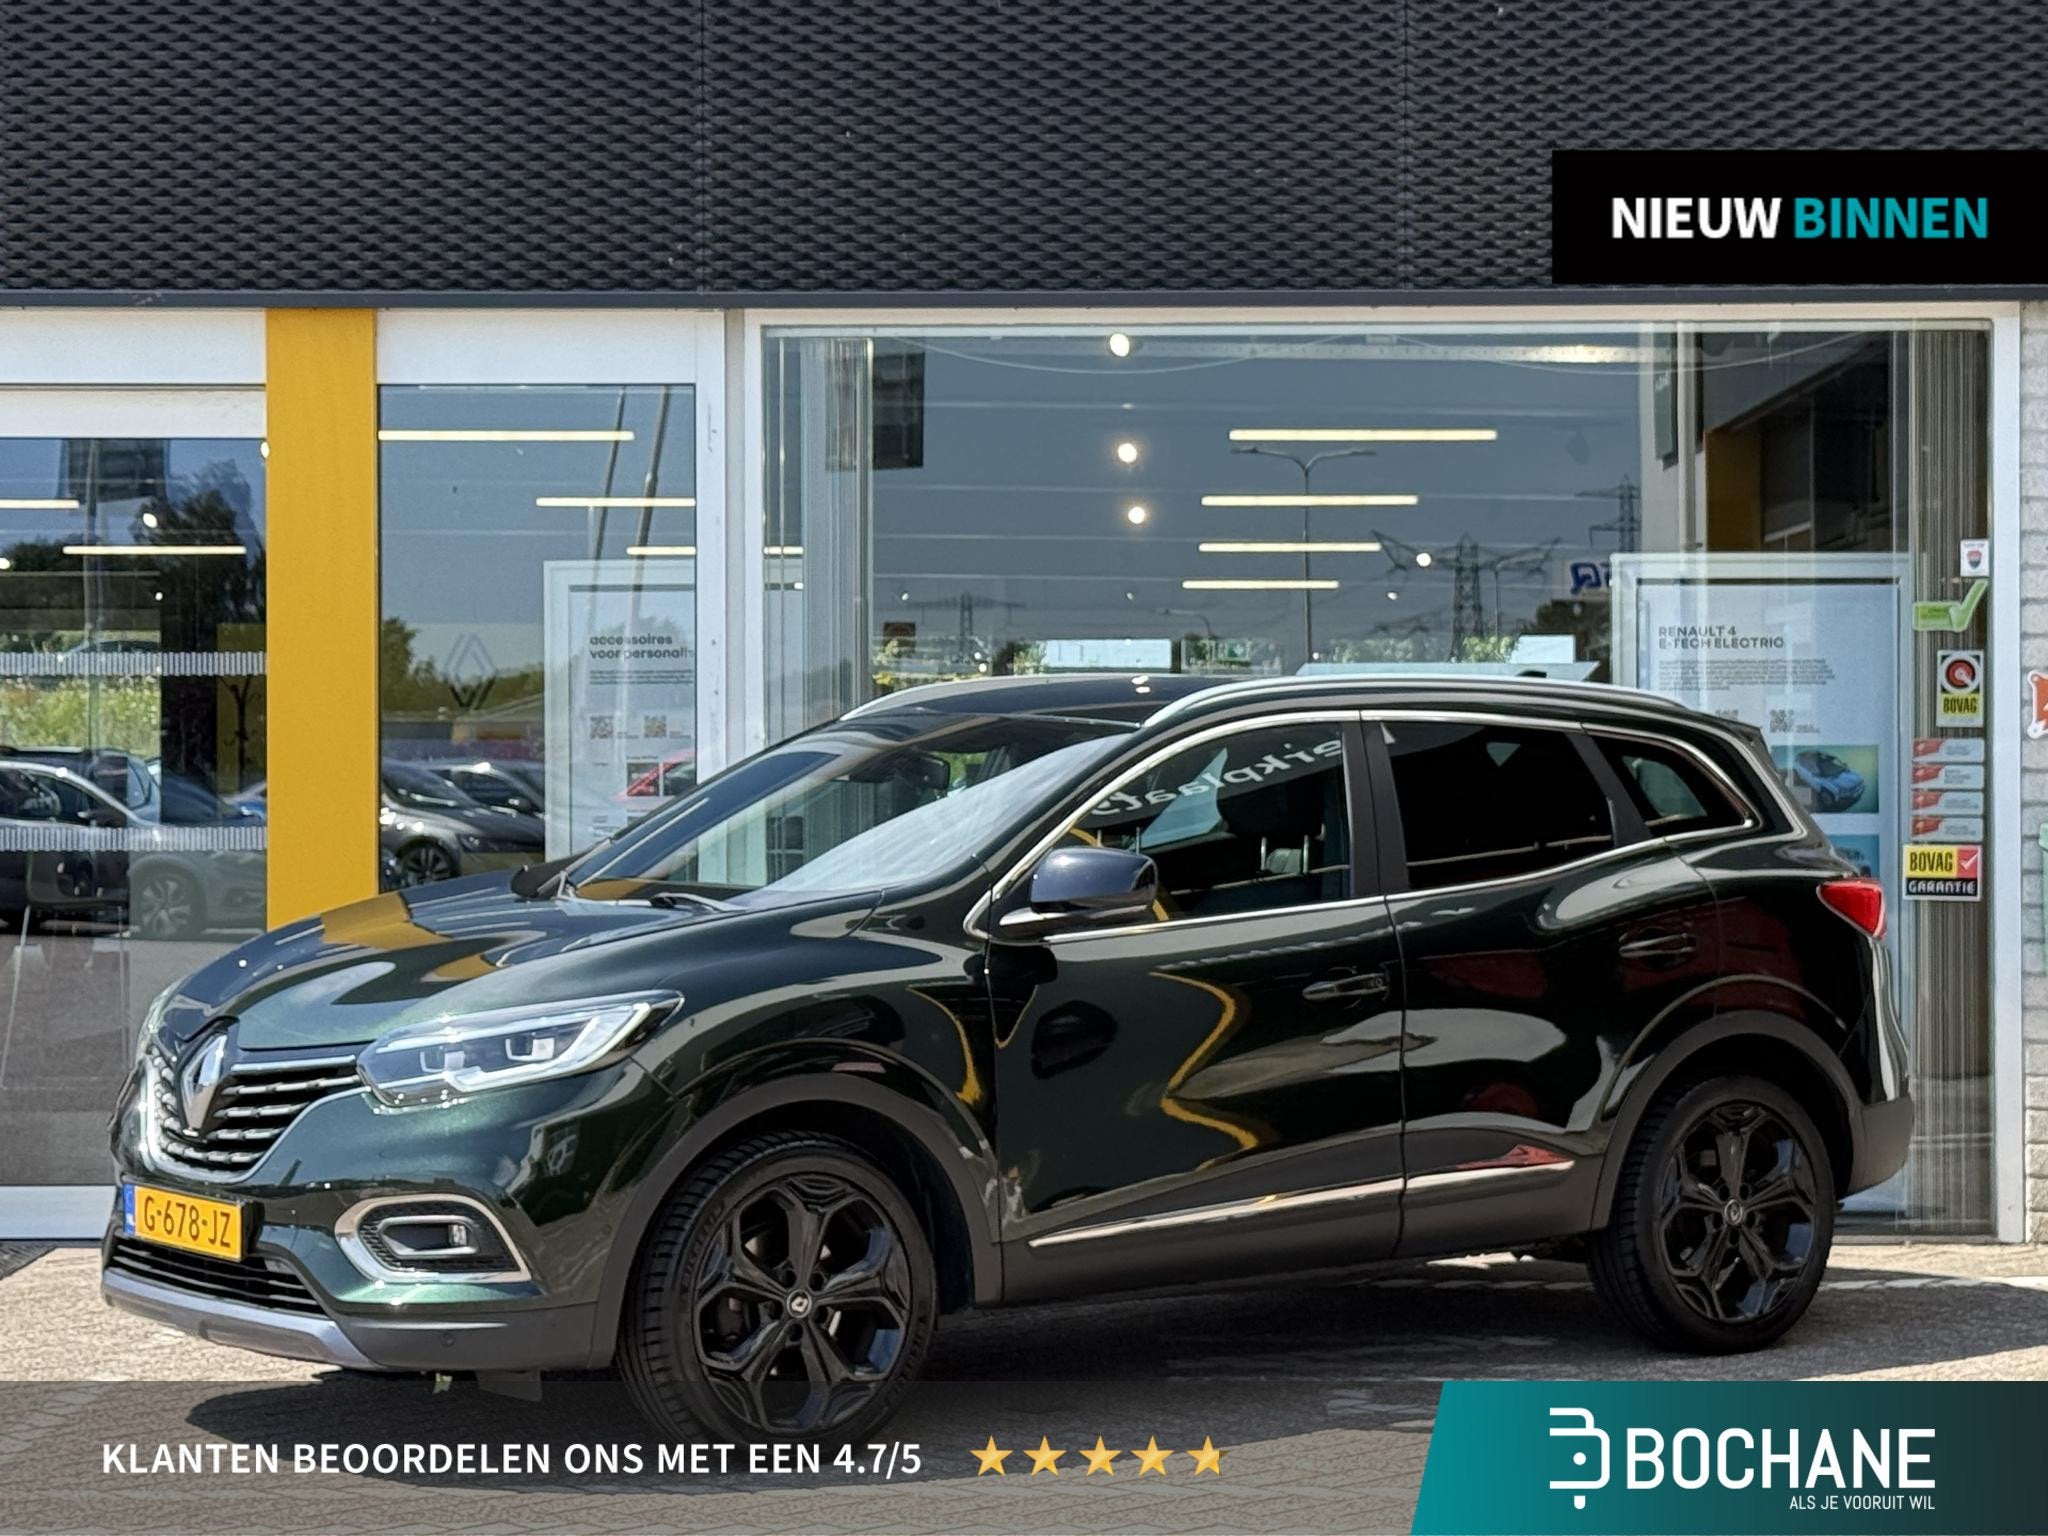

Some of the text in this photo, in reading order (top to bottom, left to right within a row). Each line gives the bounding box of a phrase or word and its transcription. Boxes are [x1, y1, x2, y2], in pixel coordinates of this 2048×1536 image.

[1658, 625, 1737, 637] RENAULT 4
[590, 633, 673, 646] accessoires
[1658, 637, 1785, 649] E-TECH ELECTRIC
[590, 649, 621, 659] voor
[1942, 697, 1978, 714] BOVAG
[1909, 851, 1953, 872] BOVAG
[1908, 880, 1977, 894] GARANTIE
[144, 1195, 232, 1249] G-678-JZ
